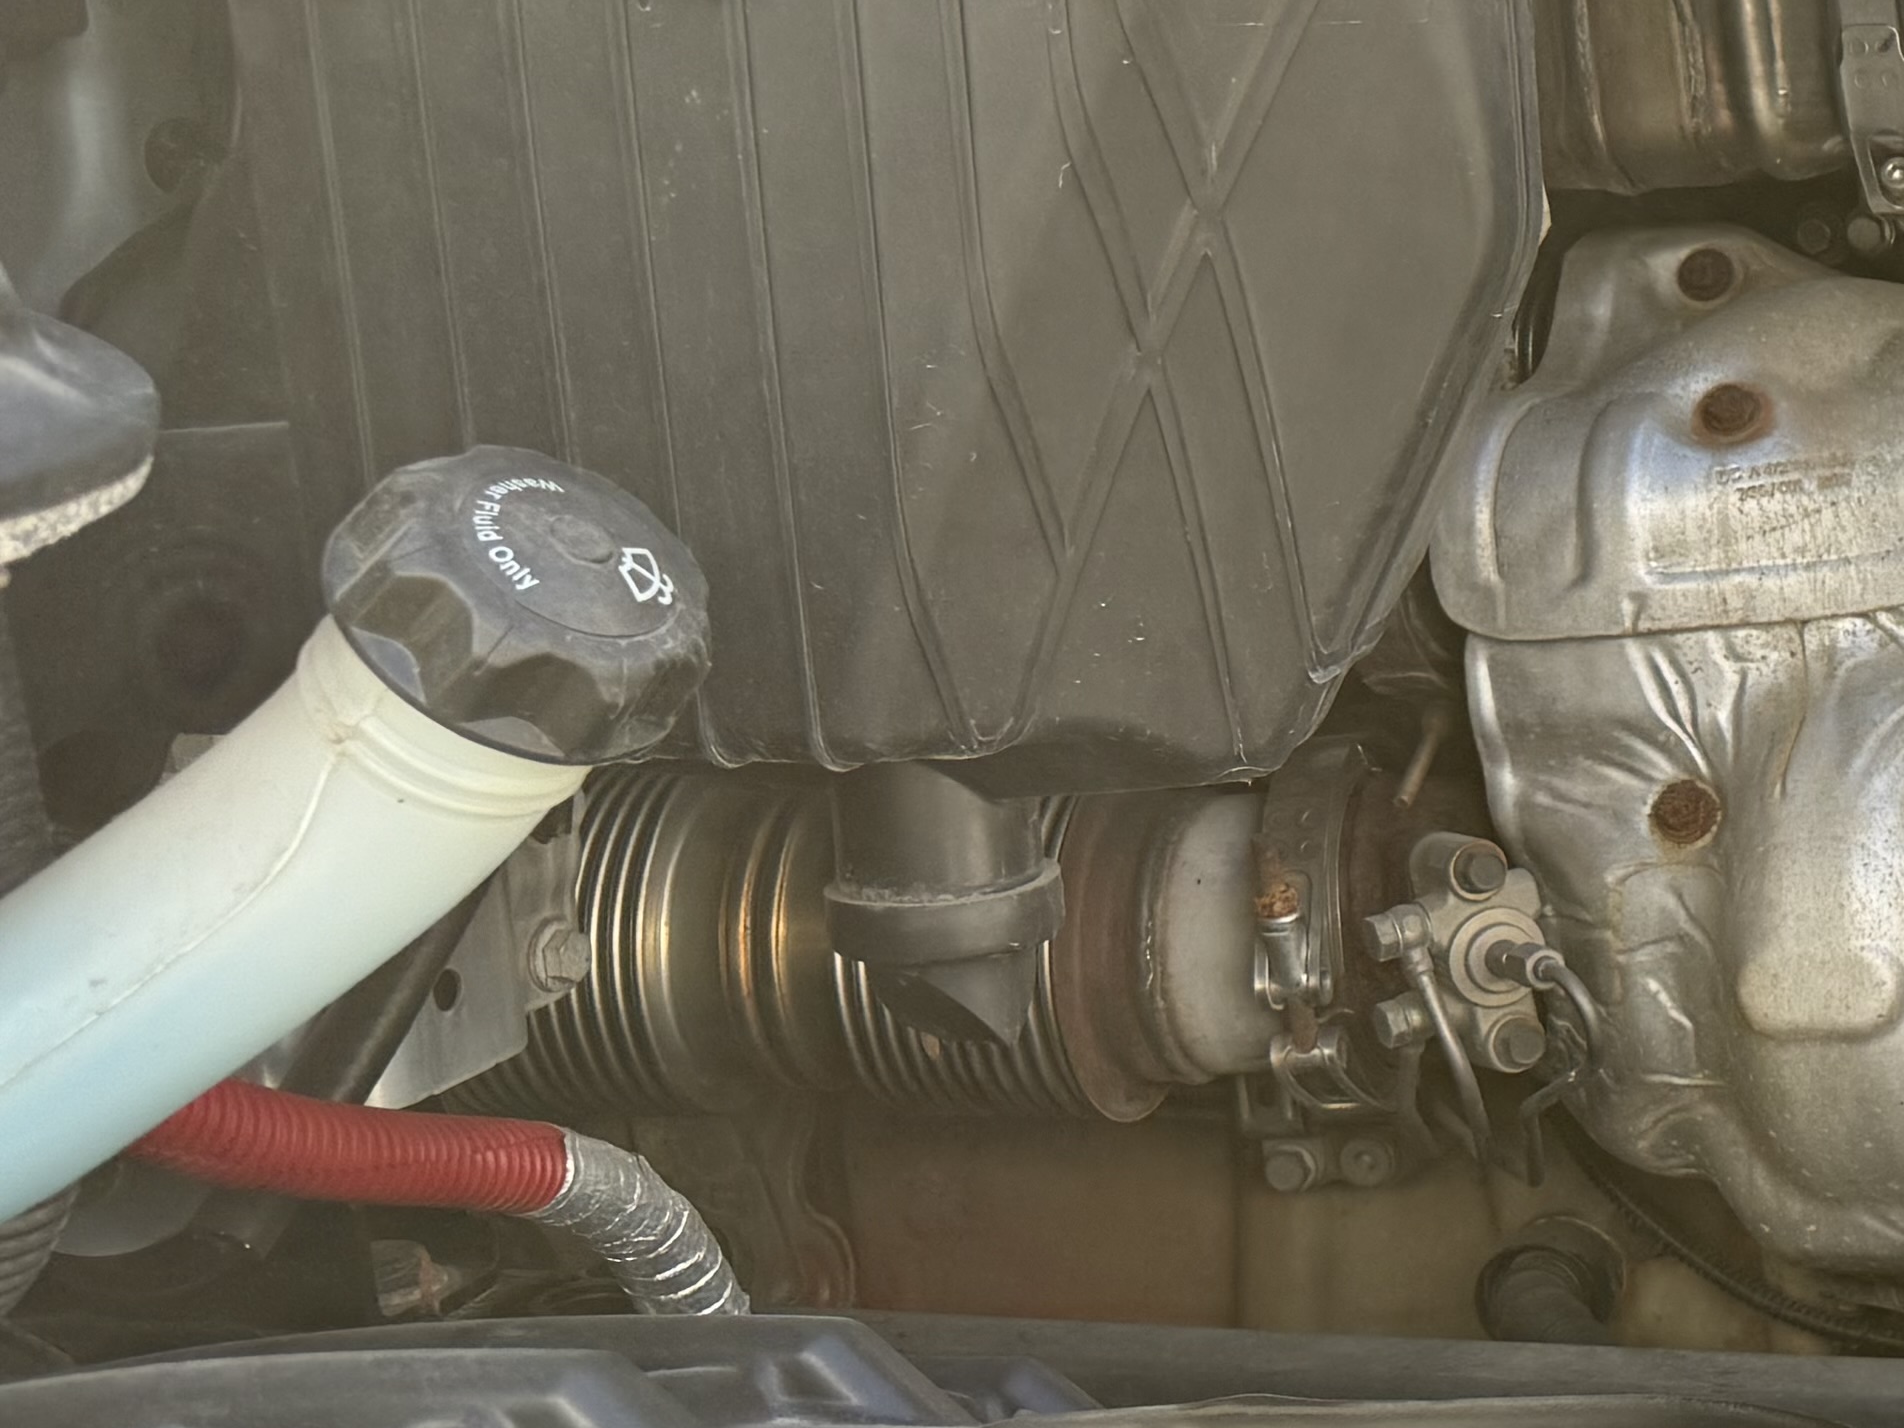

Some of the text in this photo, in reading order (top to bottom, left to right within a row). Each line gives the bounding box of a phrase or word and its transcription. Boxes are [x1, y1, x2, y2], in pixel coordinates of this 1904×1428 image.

[472, 477, 565, 591] Washer Fluid Only
